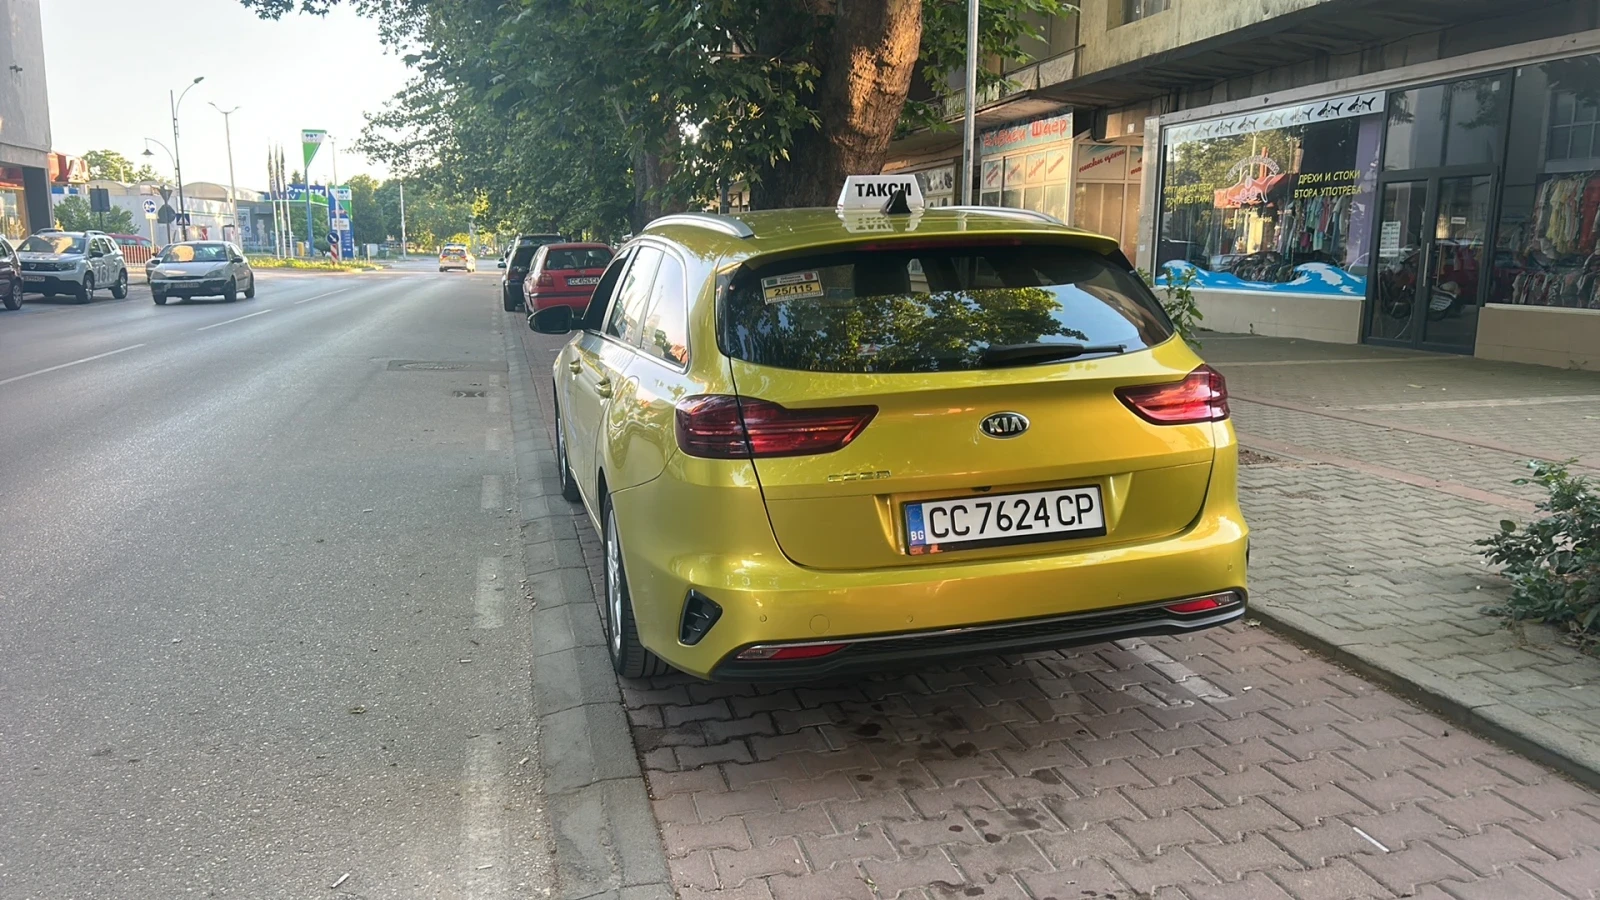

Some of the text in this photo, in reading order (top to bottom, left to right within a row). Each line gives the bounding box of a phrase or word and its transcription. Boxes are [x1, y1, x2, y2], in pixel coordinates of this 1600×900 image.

[1298, 170, 1361, 185] ДРЕХИ И СТОКИ
[1294, 185, 1362, 198] ВТОРА УПОТРЕБА
[774, 284, 813, 296] 25/115
[987, 416, 1023, 433] KIA
[910, 530, 924, 541] BG
